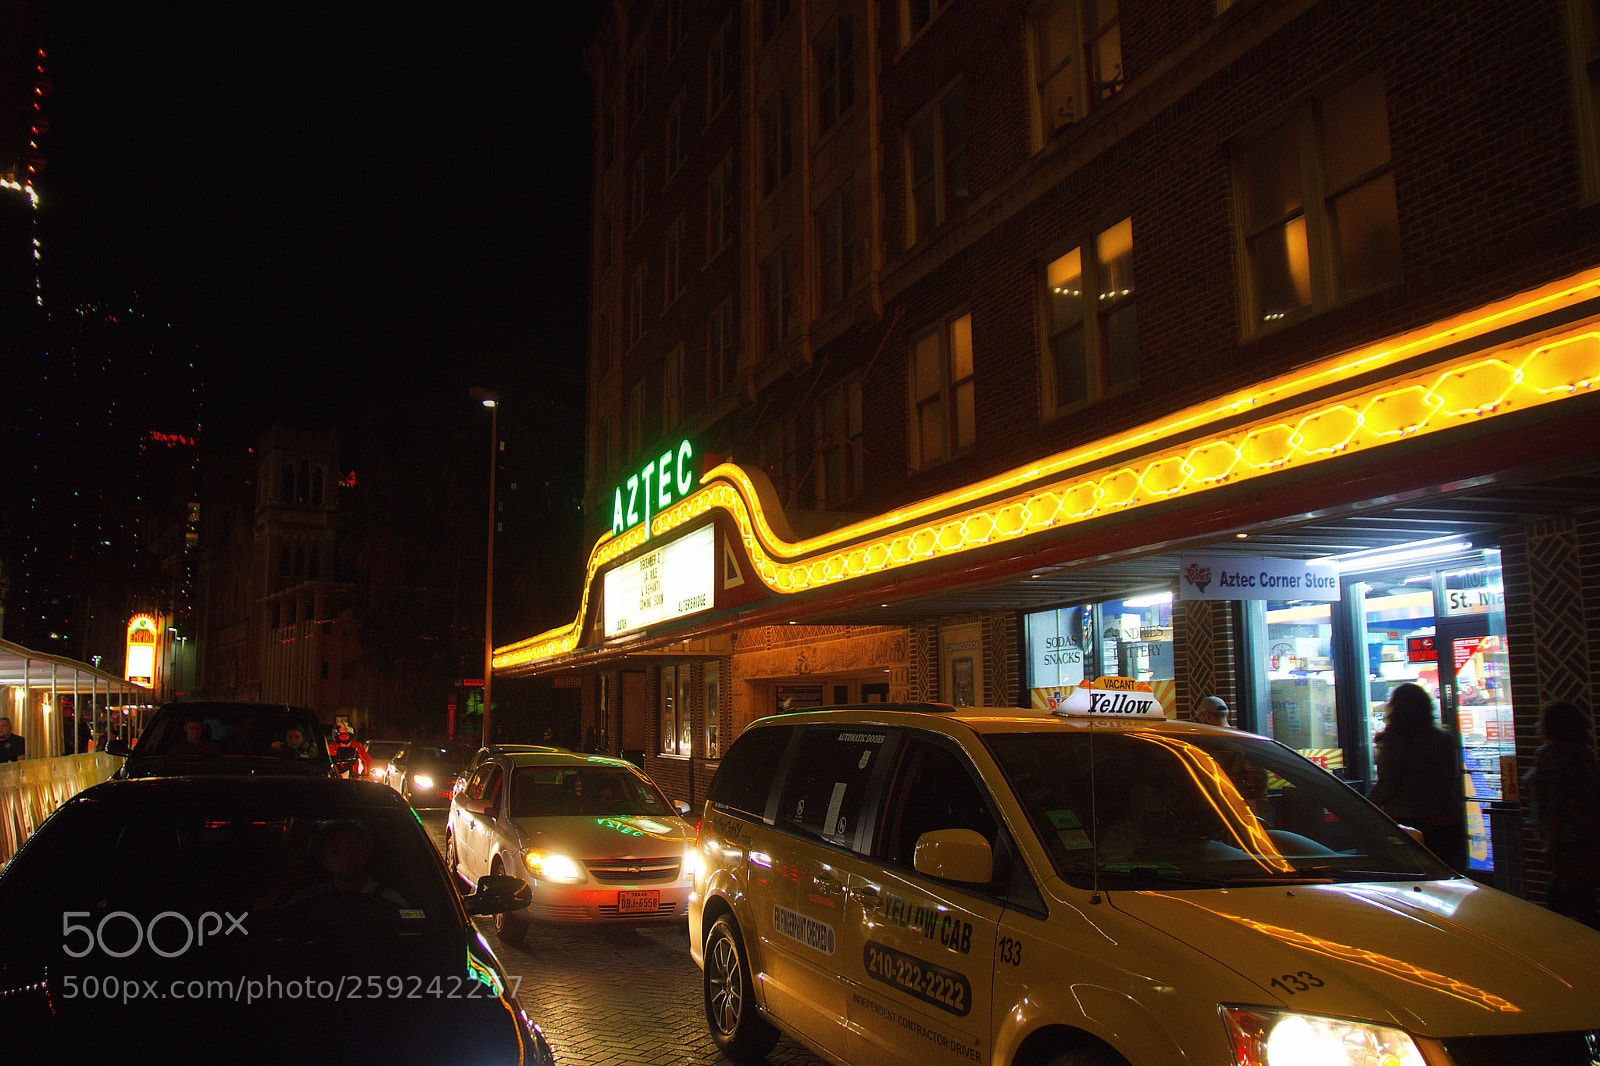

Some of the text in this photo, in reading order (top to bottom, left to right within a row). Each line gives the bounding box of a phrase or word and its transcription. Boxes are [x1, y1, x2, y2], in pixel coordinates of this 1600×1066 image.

[612, 438, 693, 540] AZTEC
[1219, 571, 1336, 588] Aztec Corner Store
[653, 592, 664, 606] SOON
[1450, 592, 1472, 609] St.
[1045, 635, 1078, 649] SODAS
[1110, 624, 1164, 643] SUNDRIES
[1113, 643, 1162, 660] LOTTERY
[1412, 638, 1422, 650] NO
[1044, 651, 1081, 666] SNACKS
[1409, 649, 1438, 662] SMOKING
[1103, 678, 1136, 690] VACANT
[1088, 693, 1153, 714] Yellow
[836, 732, 886, 744] AUTOMATIC DOORS
[885, 891, 973, 954] YELLOW CAB
[998, 935, 1022, 967] 133
[868, 948, 965, 1008] 210-222-2222
[1270, 970, 1326, 997] 133
[852, 992, 983, 1064] INDEPENDENT CONTRACTOR DRIVER
